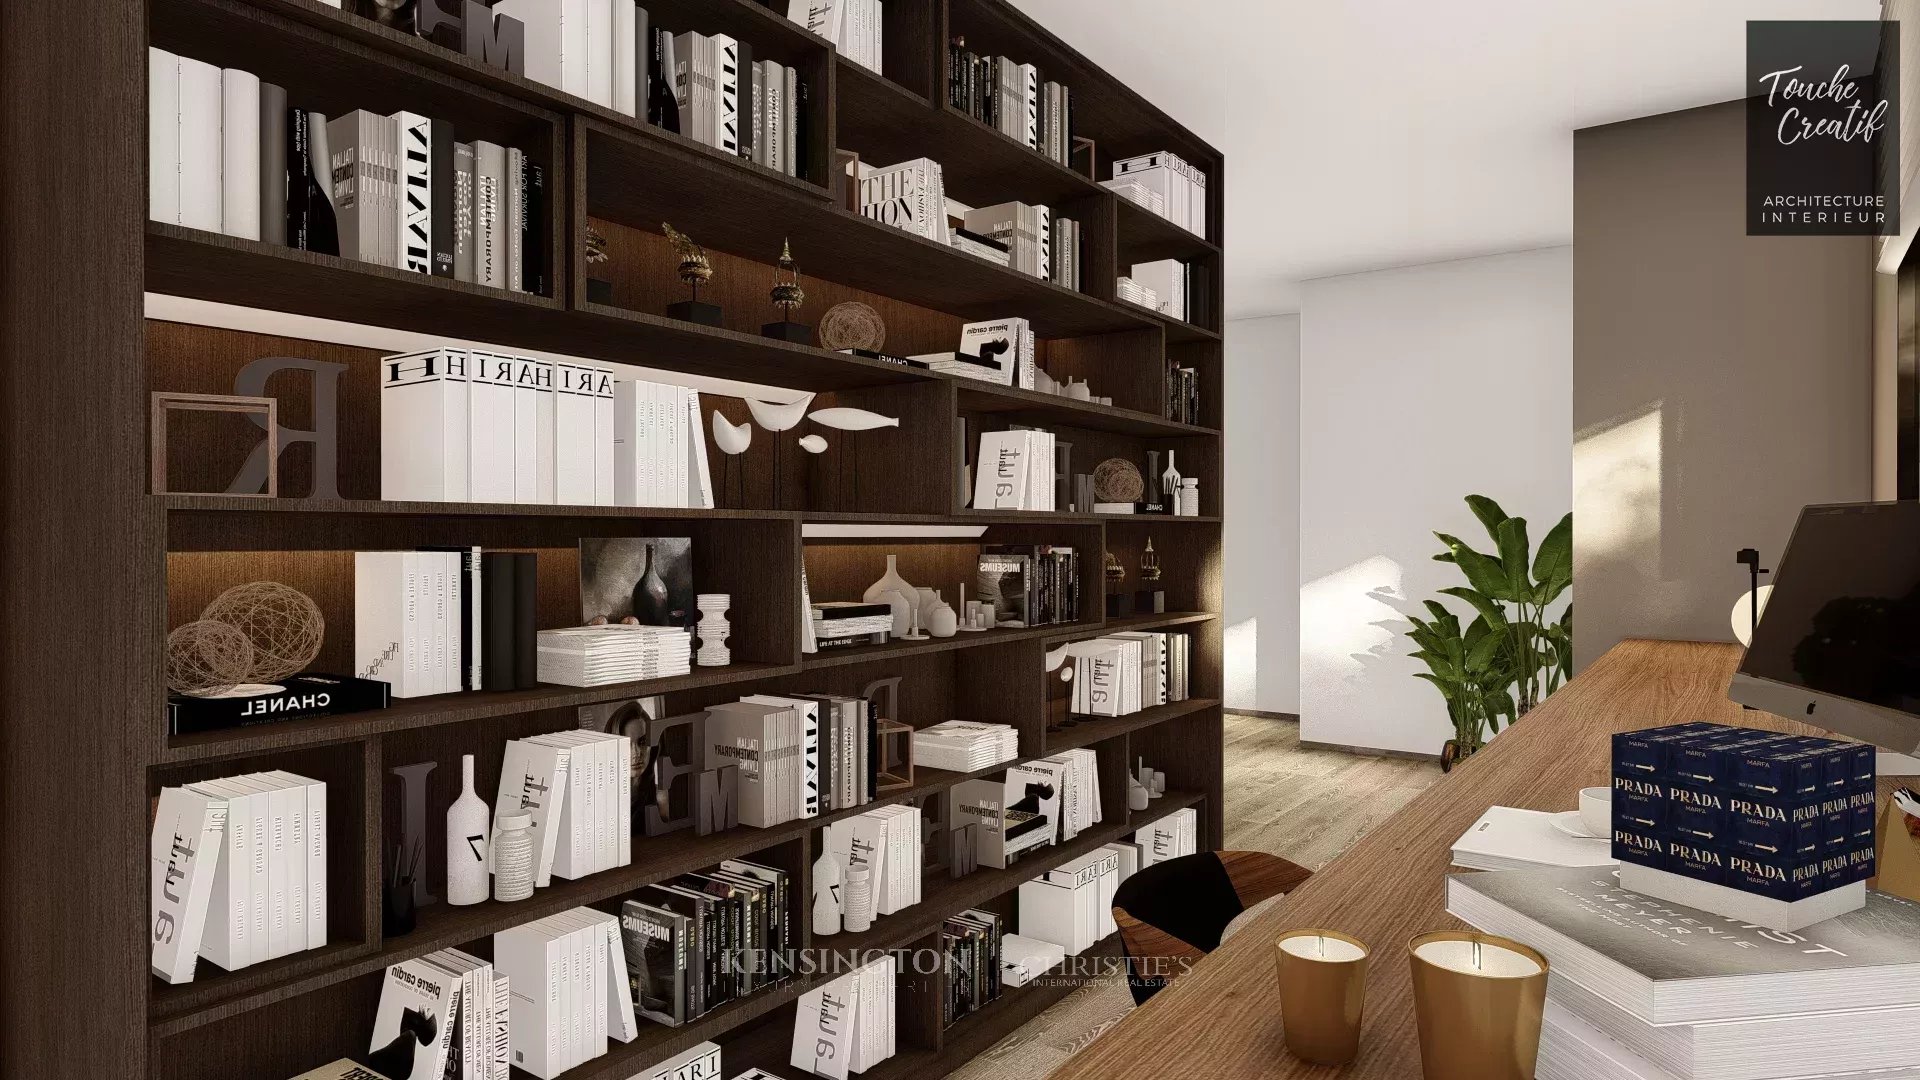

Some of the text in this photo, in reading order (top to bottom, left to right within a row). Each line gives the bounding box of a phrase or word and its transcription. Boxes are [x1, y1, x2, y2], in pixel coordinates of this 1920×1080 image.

[862, 168, 914, 207] THE
[1615, 777, 1663, 798] PRADA
[1670, 787, 1722, 810] PRADA
[1730, 799, 1787, 823] PRADA
[1822, 797, 1848, 816] PRADA
[1850, 790, 1875, 809] PRADA
[1793, 804, 1819, 823] PRADA
[1615, 830, 1663, 853] PRADA
[1670, 842, 1722, 867] PRADA
[1822, 854, 1848, 874] PRADA
[1850, 846, 1875, 865] PRADA
[1730, 855, 1787, 882] PRADA
[1793, 862, 1819, 882] PRADA
[1590, 880, 1760, 949] STEPHENIE
[1593, 894, 1692, 935] MEYER
